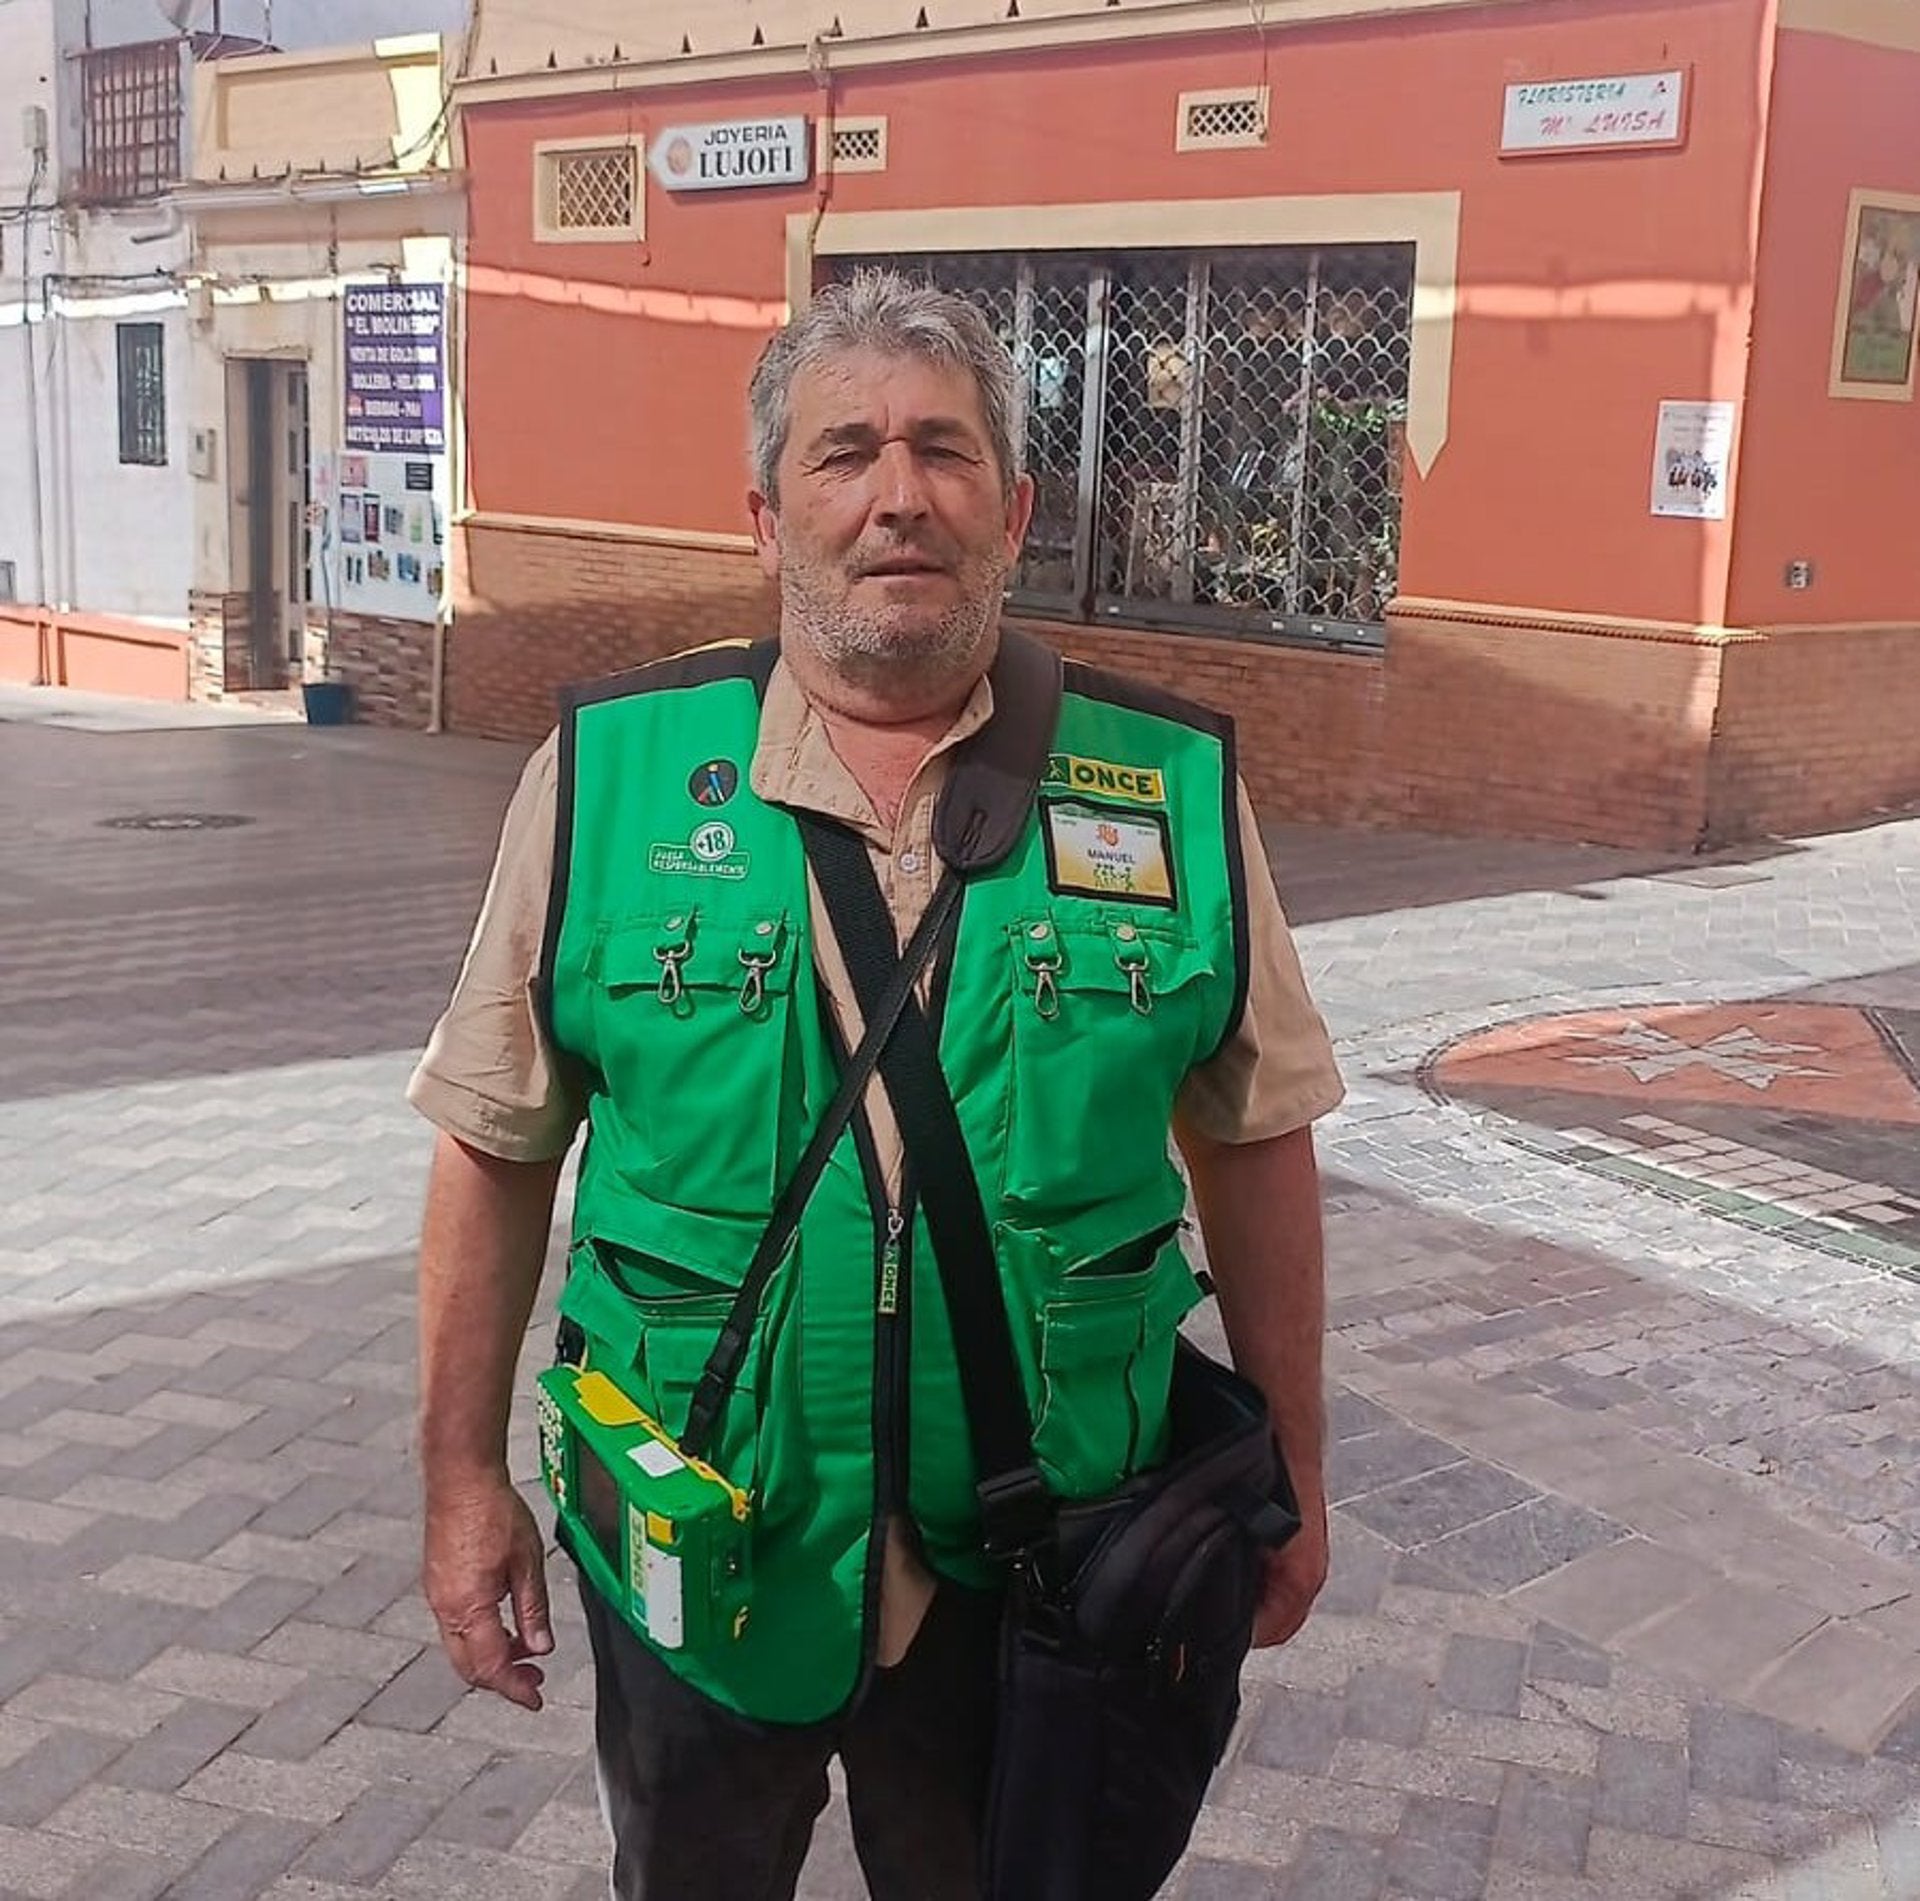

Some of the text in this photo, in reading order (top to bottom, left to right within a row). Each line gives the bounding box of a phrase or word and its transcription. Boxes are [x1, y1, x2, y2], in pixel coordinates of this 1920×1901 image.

[704, 125, 788, 146] JOYERIA
[700, 147, 792, 178] LUJOFI
[347, 290, 440, 312] COMERCIAL
[1075, 764, 1154, 795] ONCE
[697, 829, 725, 854] +18
[884, 1266, 895, 1308] ONCE
